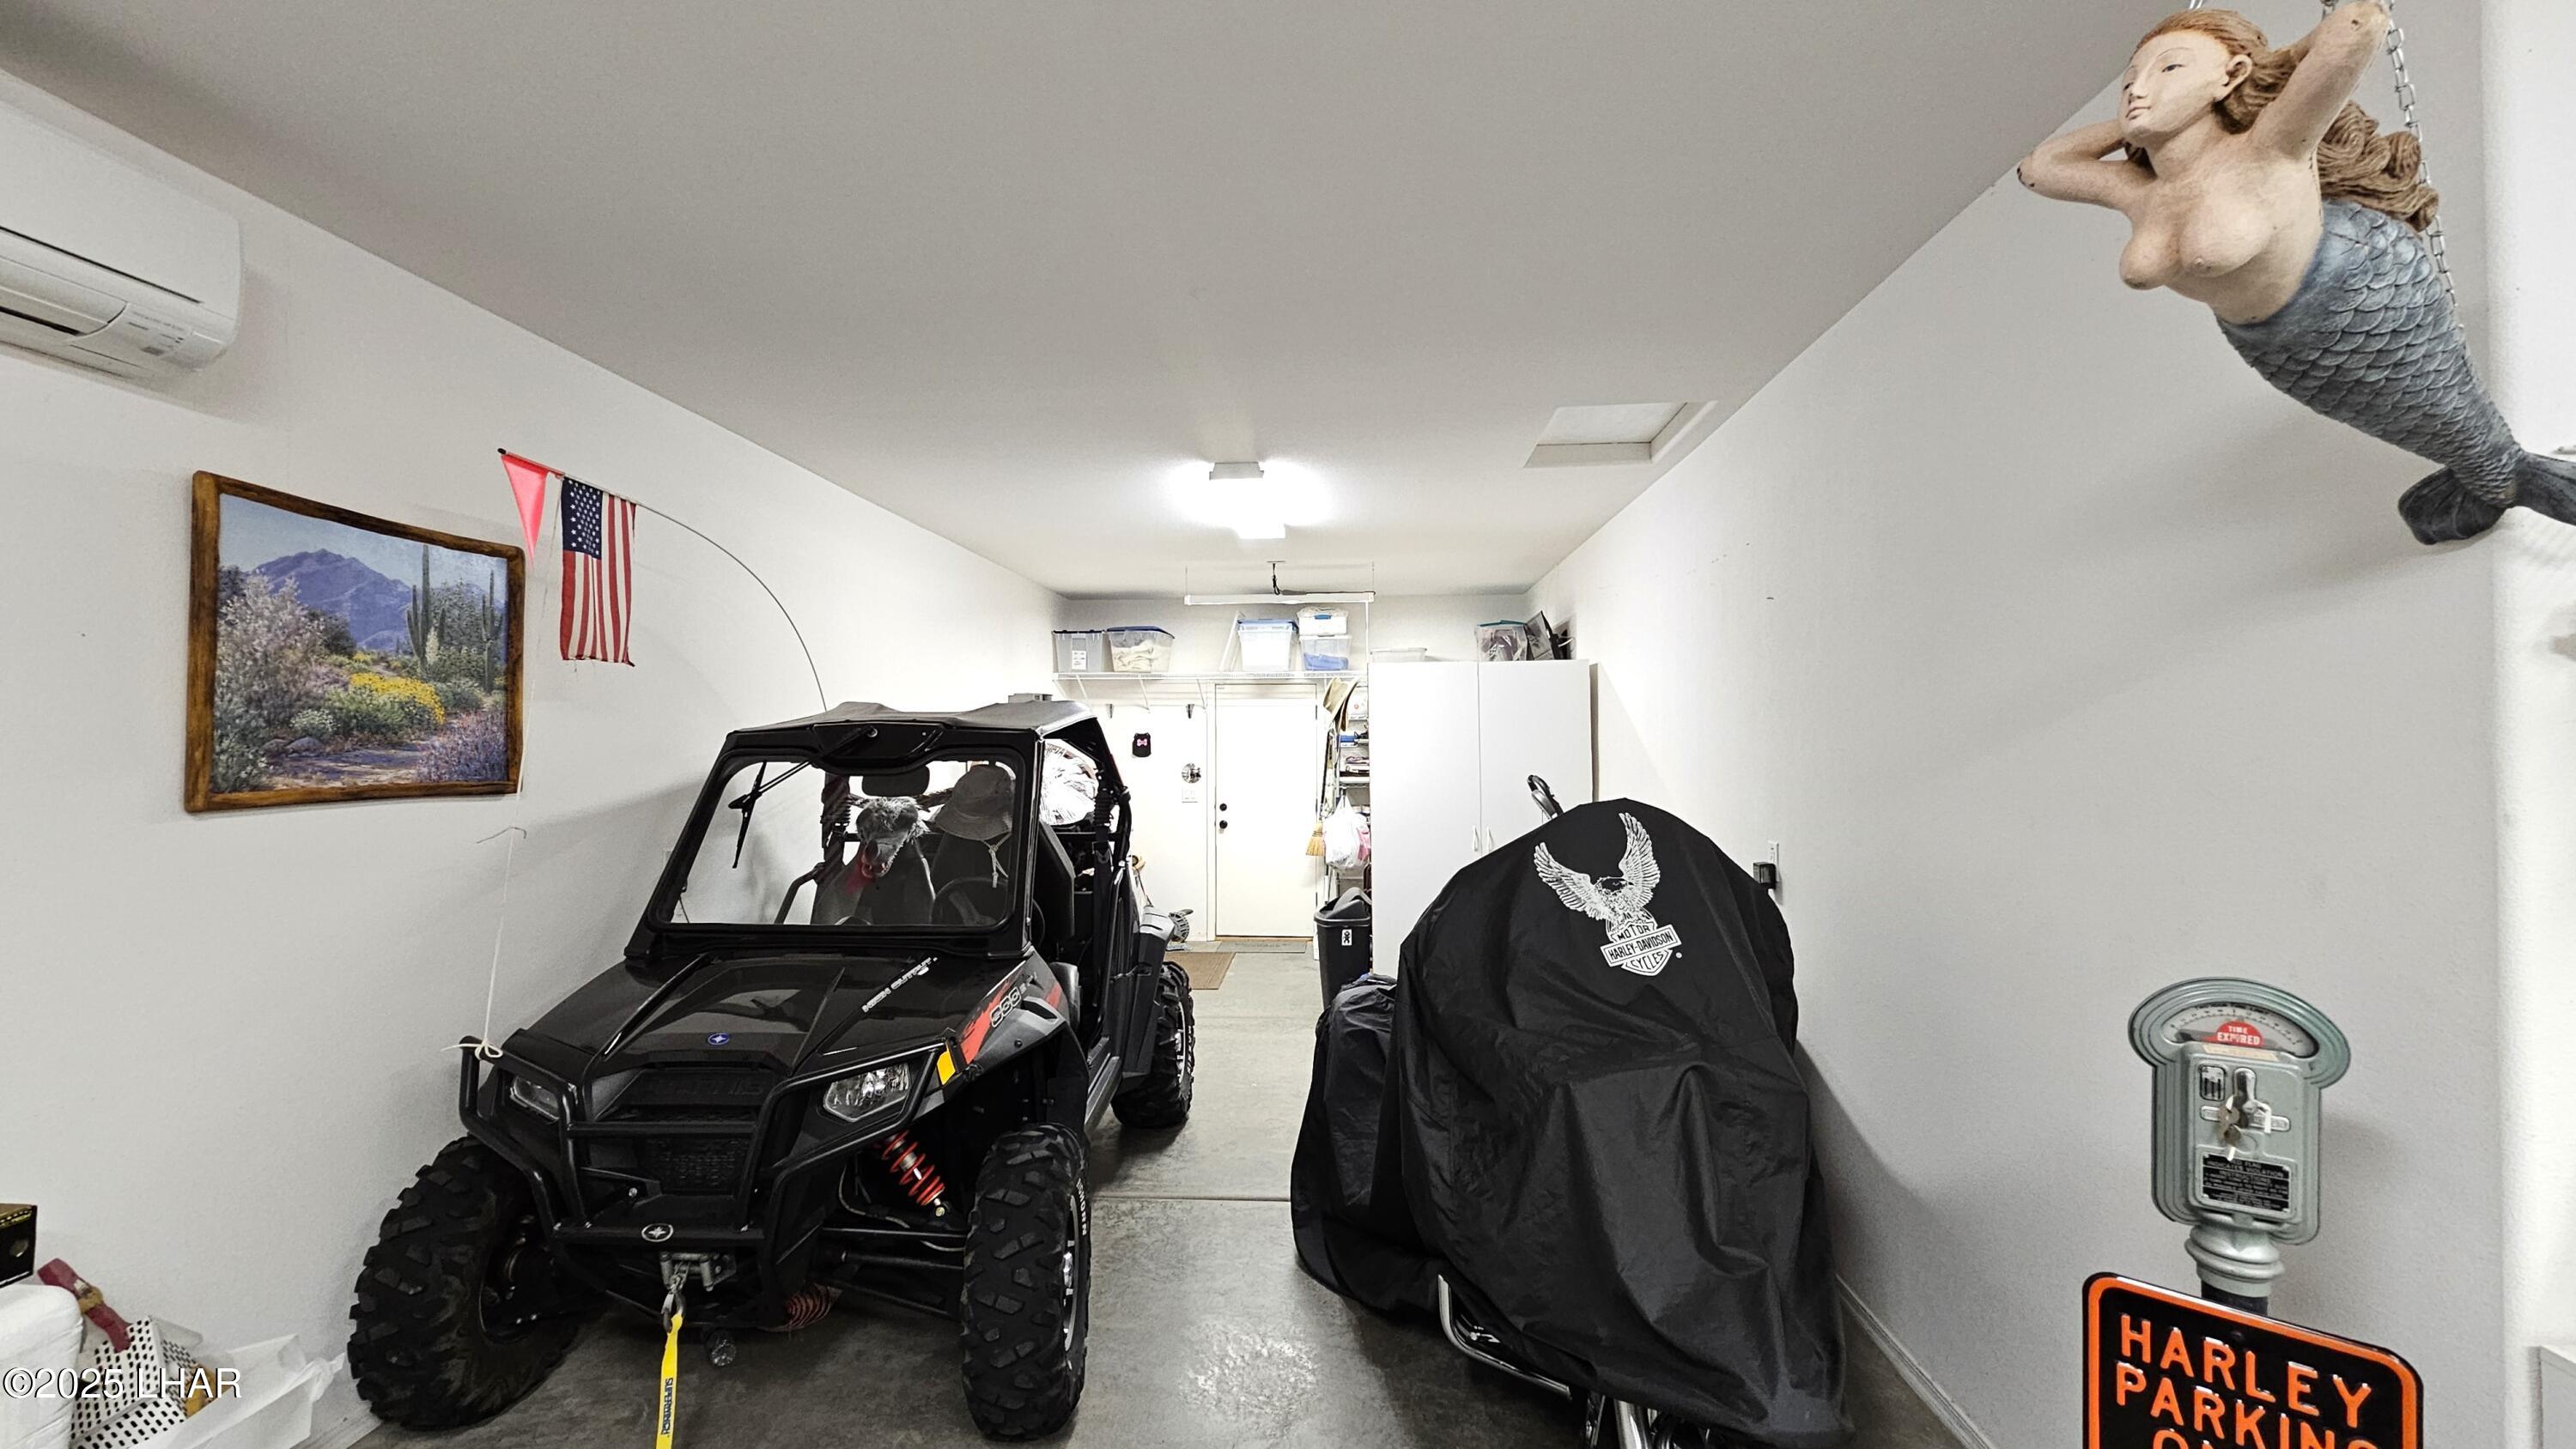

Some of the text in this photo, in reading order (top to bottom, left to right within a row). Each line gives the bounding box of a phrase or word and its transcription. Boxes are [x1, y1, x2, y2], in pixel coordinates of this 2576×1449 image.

[1618, 925, 1650, 941] MOTOR
[1607, 931, 1674, 960] HARLEY-DAVIDSON
[1631, 950, 1664, 970] CYCLES
[2216, 1032, 2262, 1046] EXPIRED
[2227, 1025, 2249, 1034] TIME
[2120, 1313, 2372, 1428] HARLEY
[2116, 1361, 2379, 1449] PARKIN
